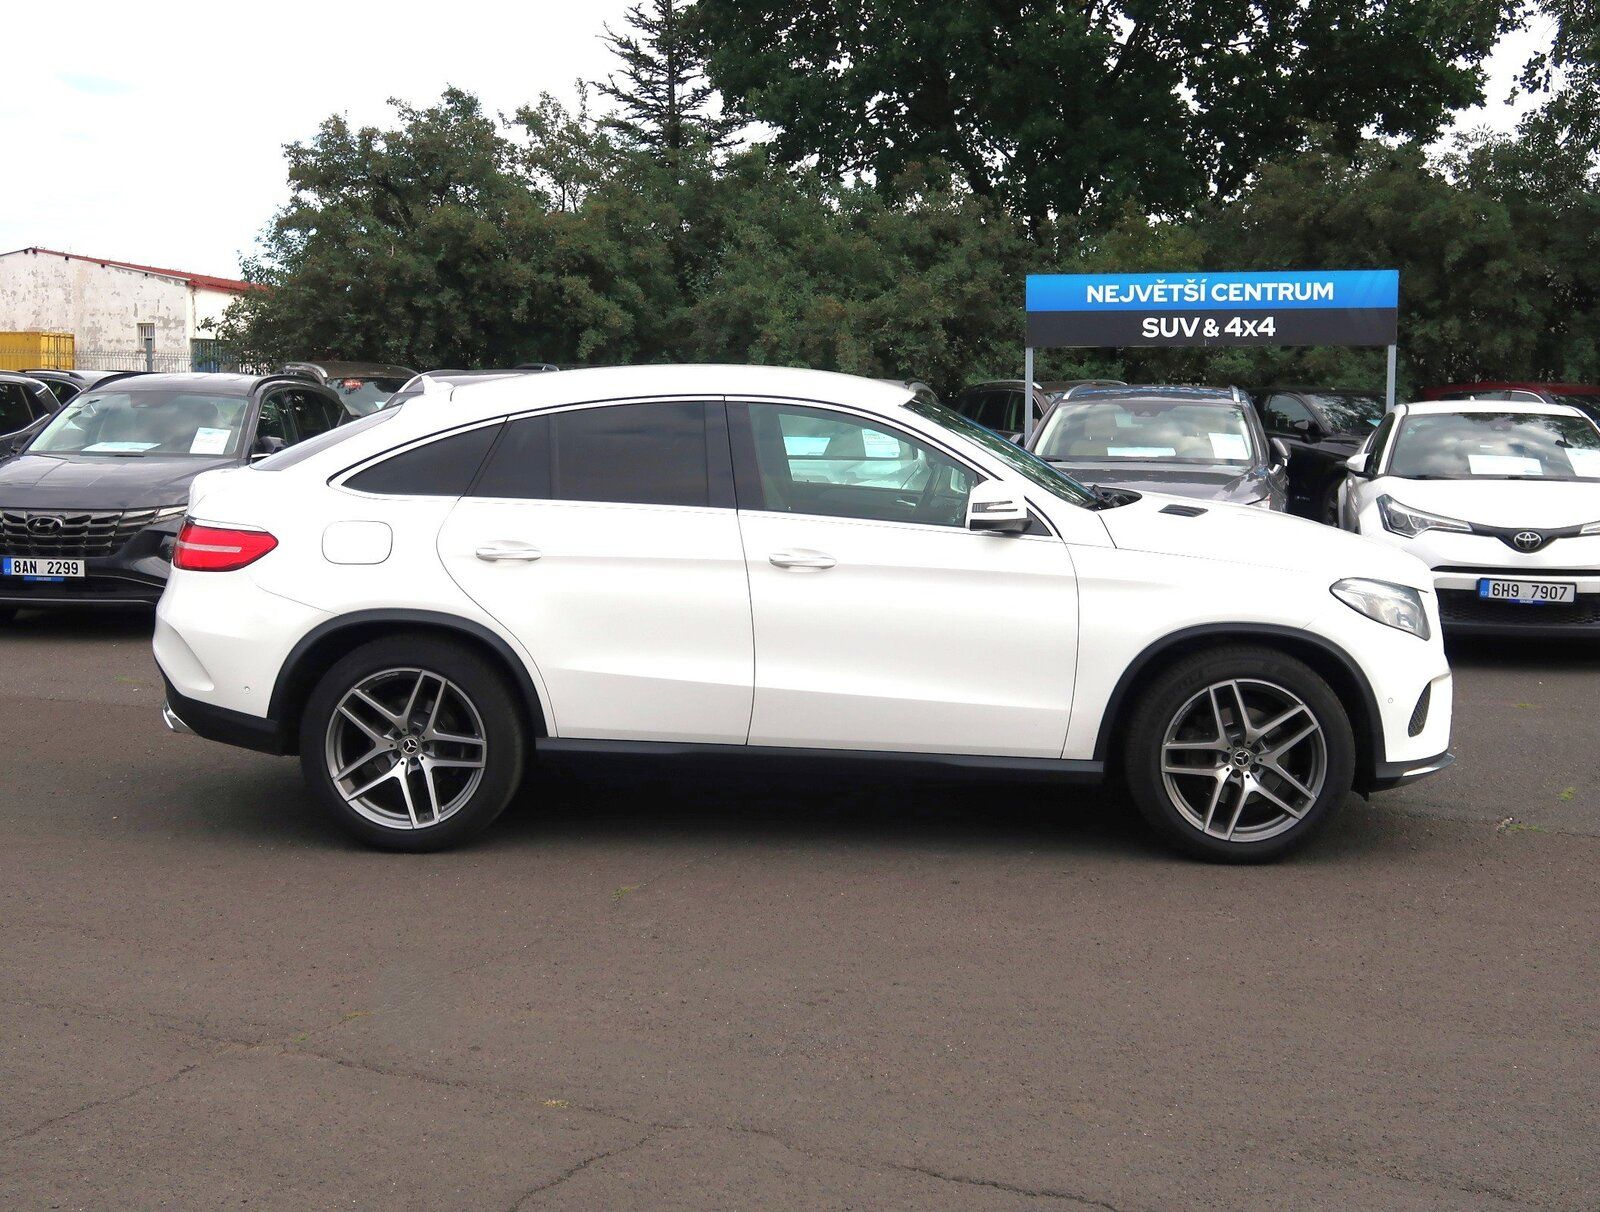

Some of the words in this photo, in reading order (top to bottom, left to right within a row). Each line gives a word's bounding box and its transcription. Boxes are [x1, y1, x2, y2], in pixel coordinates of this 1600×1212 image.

[1086, 279, 1207, 302] NEJVĚTŠÍ
[1211, 282, 1334, 301] CENTRUM
[1141, 317, 1200, 338] SUV
[1202, 318, 1220, 338] &
[1224, 316, 1276, 337] 4x4
[14, 560, 37, 574] 8AN
[47, 561, 79, 575] 2299
[1492, 583, 1520, 598] 6H9
[1531, 585, 1568, 600] 7907
